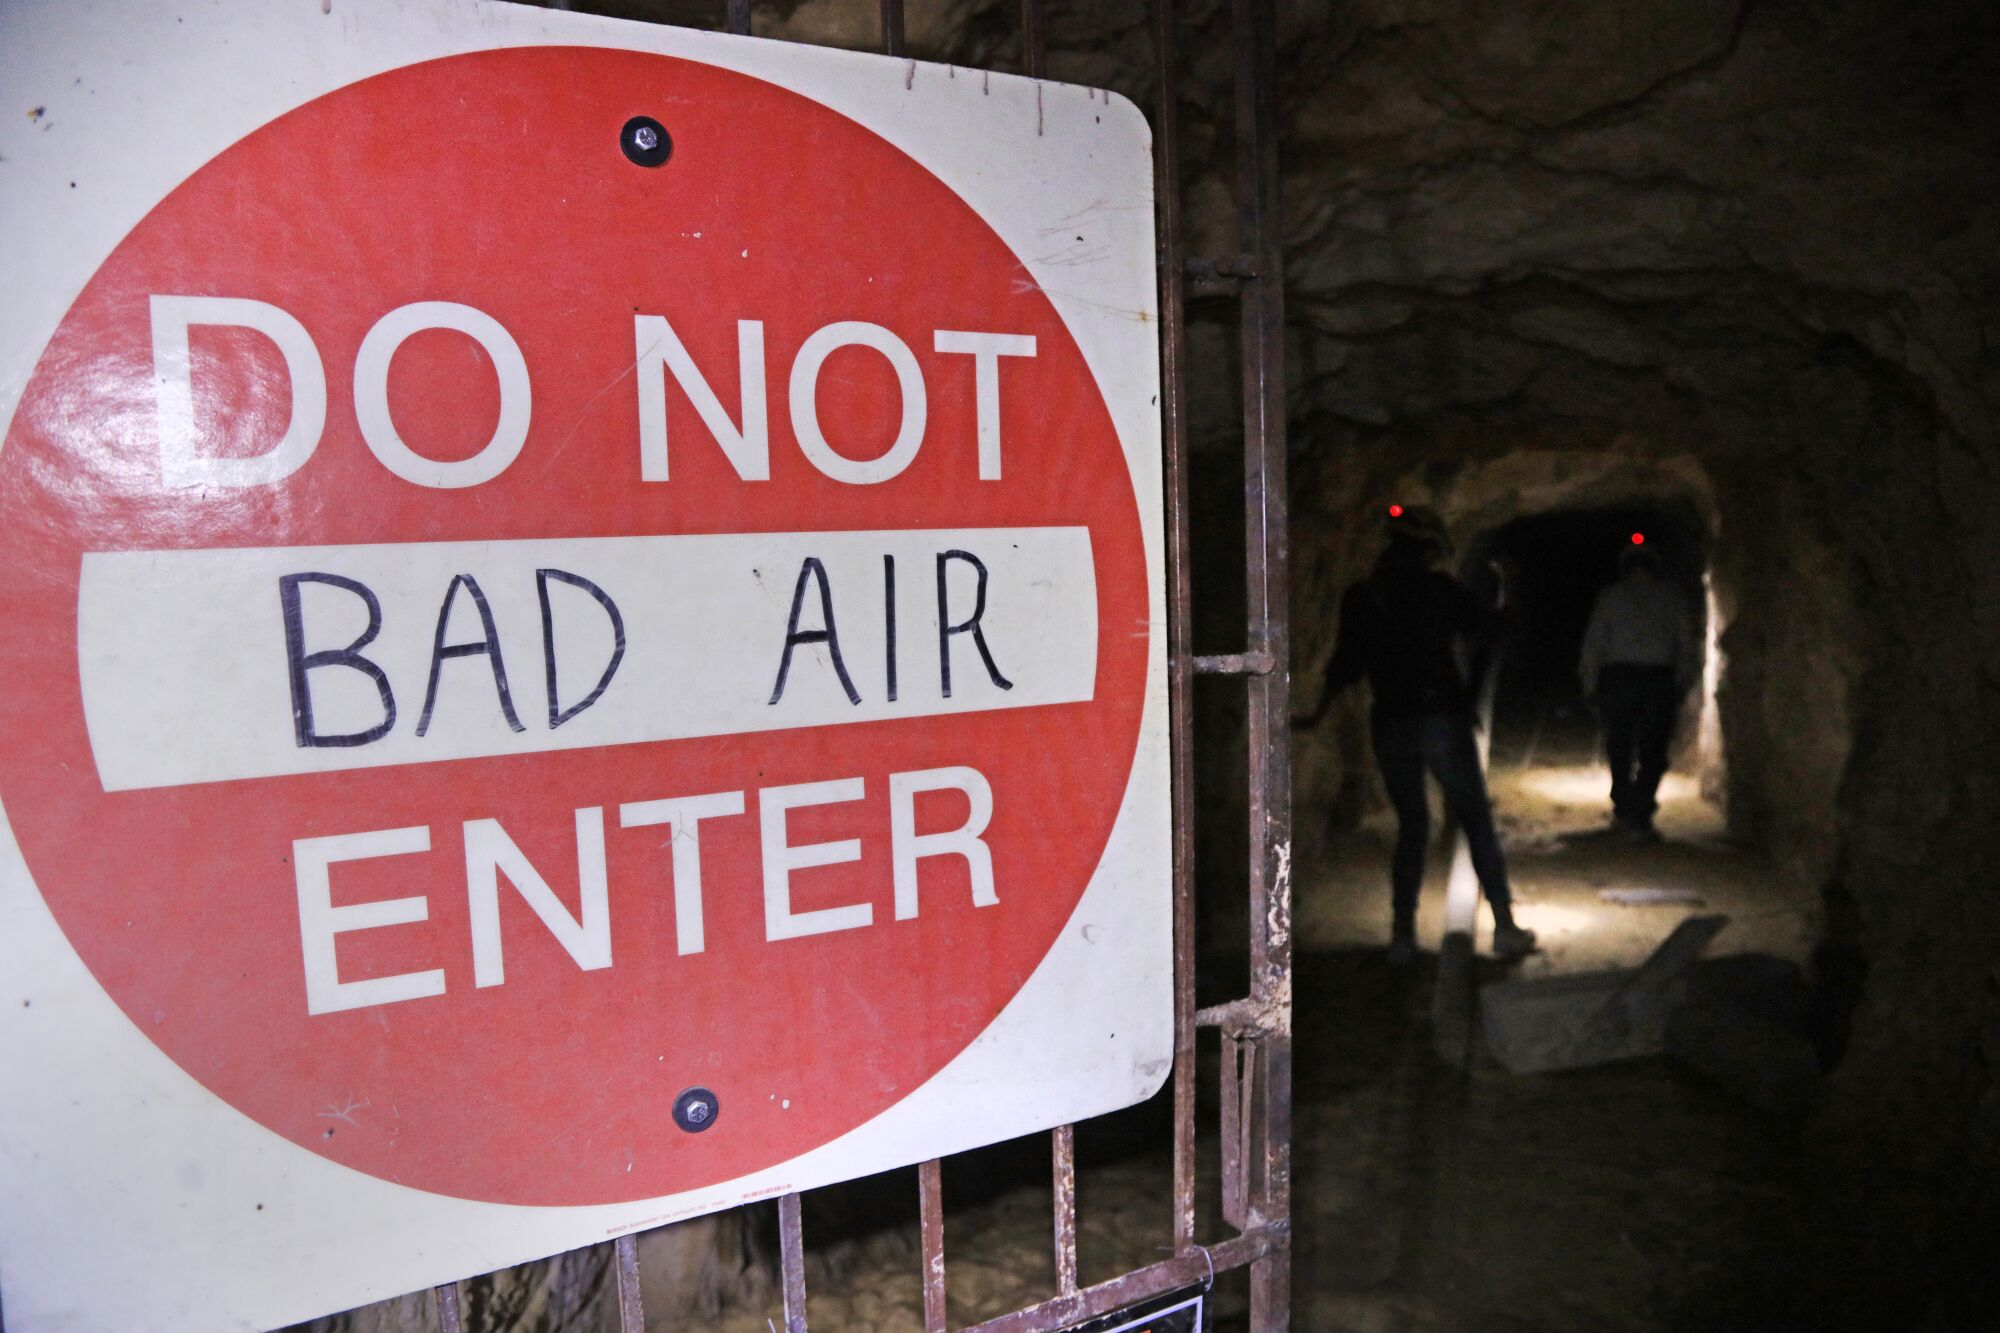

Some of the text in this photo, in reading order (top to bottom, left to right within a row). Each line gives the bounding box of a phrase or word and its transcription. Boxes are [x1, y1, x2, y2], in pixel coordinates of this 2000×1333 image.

[149, 294, 1037, 489] DO NOT
[279, 549, 1013, 748] BAD AIR
[292, 765, 1000, 1016] ENTER
